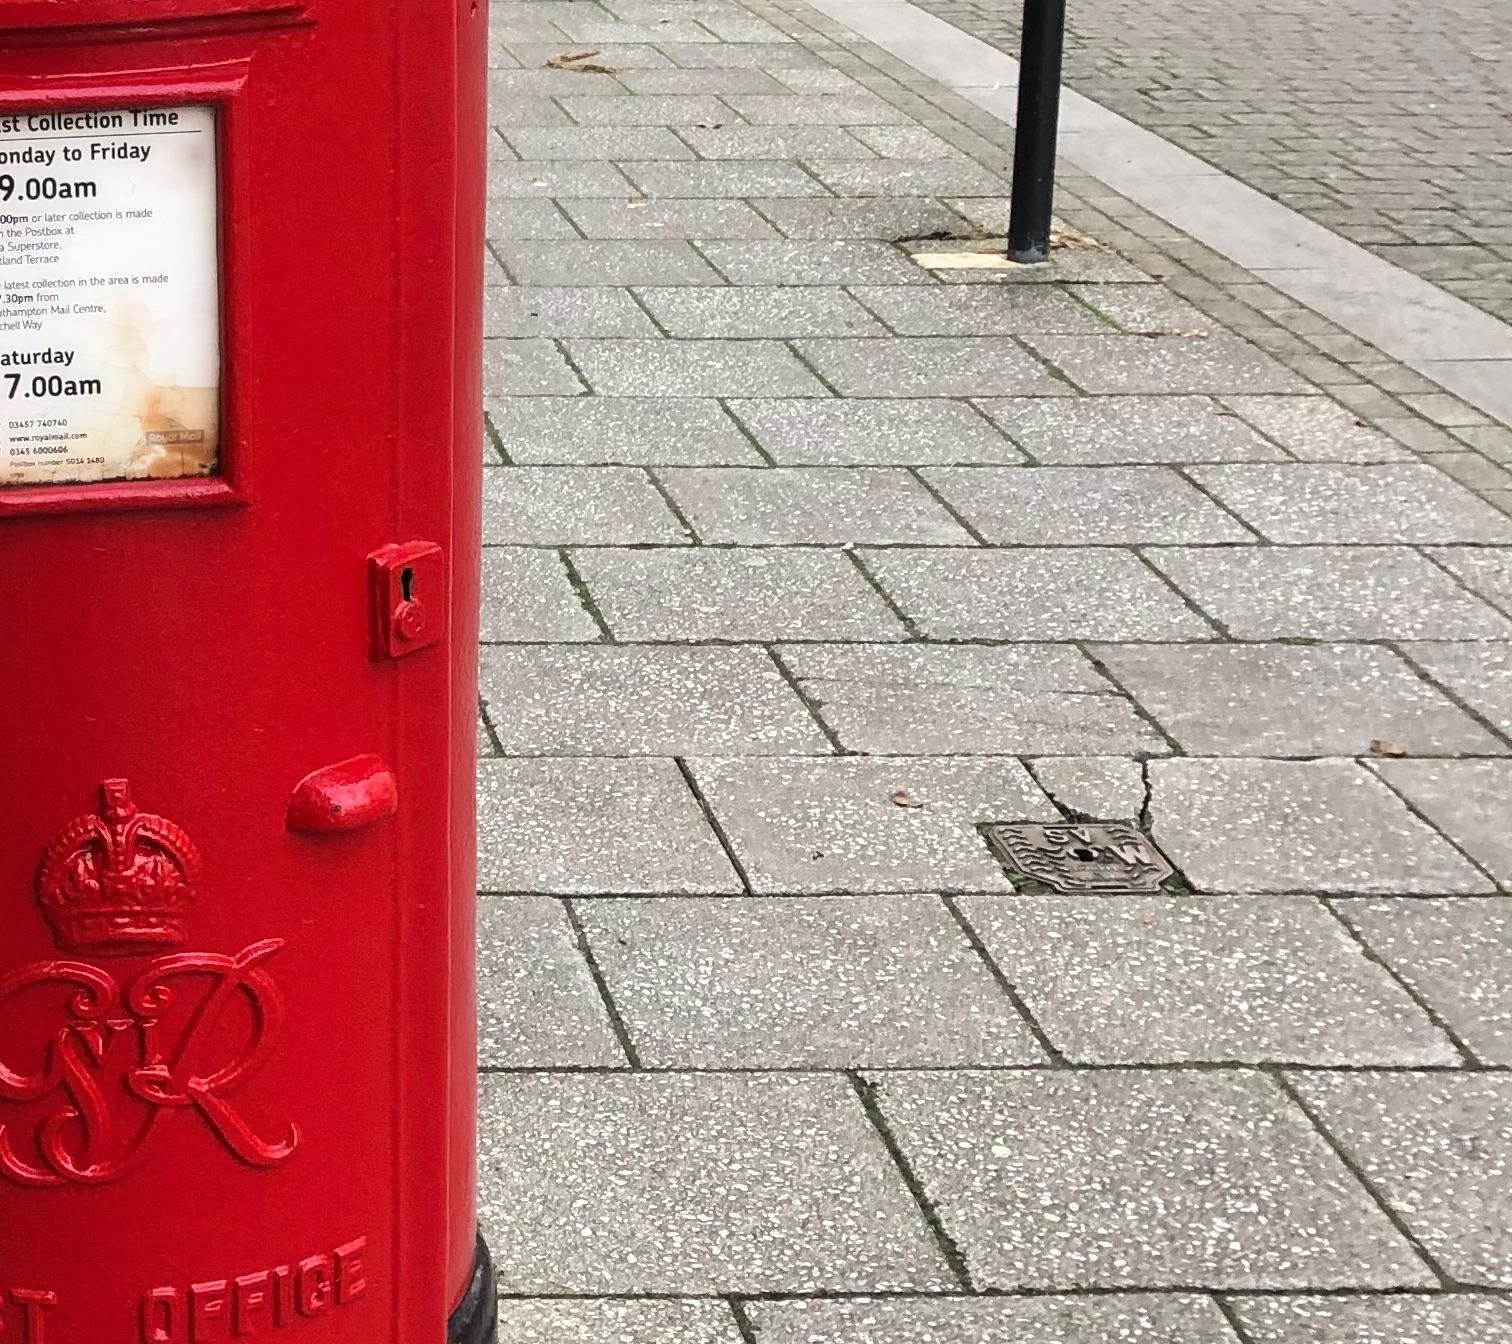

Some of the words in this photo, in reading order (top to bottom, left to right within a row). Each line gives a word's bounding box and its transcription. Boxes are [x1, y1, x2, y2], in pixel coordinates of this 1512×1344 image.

[28, 111, 123, 132] Collection
[131, 109, 179, 127] Time
[63, 146, 82, 162] to
[90, 142, 151, 163] Friday
[31, 215, 42, 223] or
[44, 212, 66, 223] later
[69, 210, 113, 222] collection
[115, 208, 124, 219] is
[126, 208, 153, 219] made
[6, 228, 23, 238] the
[25, 226, 63, 237] Postbox
[65, 226, 75, 235] at
[25, 254, 60, 265] Terrace
[4, 279, 30, 290] latest
[32, 278, 76, 289] collection
[78, 276, 87, 287] in
[89, 276, 106, 286] the
[108, 276, 129, 285] area
[131, 274, 139, 284] is
[142, 273, 169, 284] made
[36, 292, 59, 303] from
[51, 304, 70, 315] Mail
[73, 303, 107, 315] Centre,
[22, 319, 43, 332] Way
[3, 373, 102, 399] 7.00am
[8, 420, 34, 429] 03457
[37, 418, 68, 428] 740740
[9, 431, 88, 443] www.royalmail.com
[9, 447, 30, 457] 0345
[1044, 828, 1092, 845] SV
[1105, 844, 1154, 865] W
